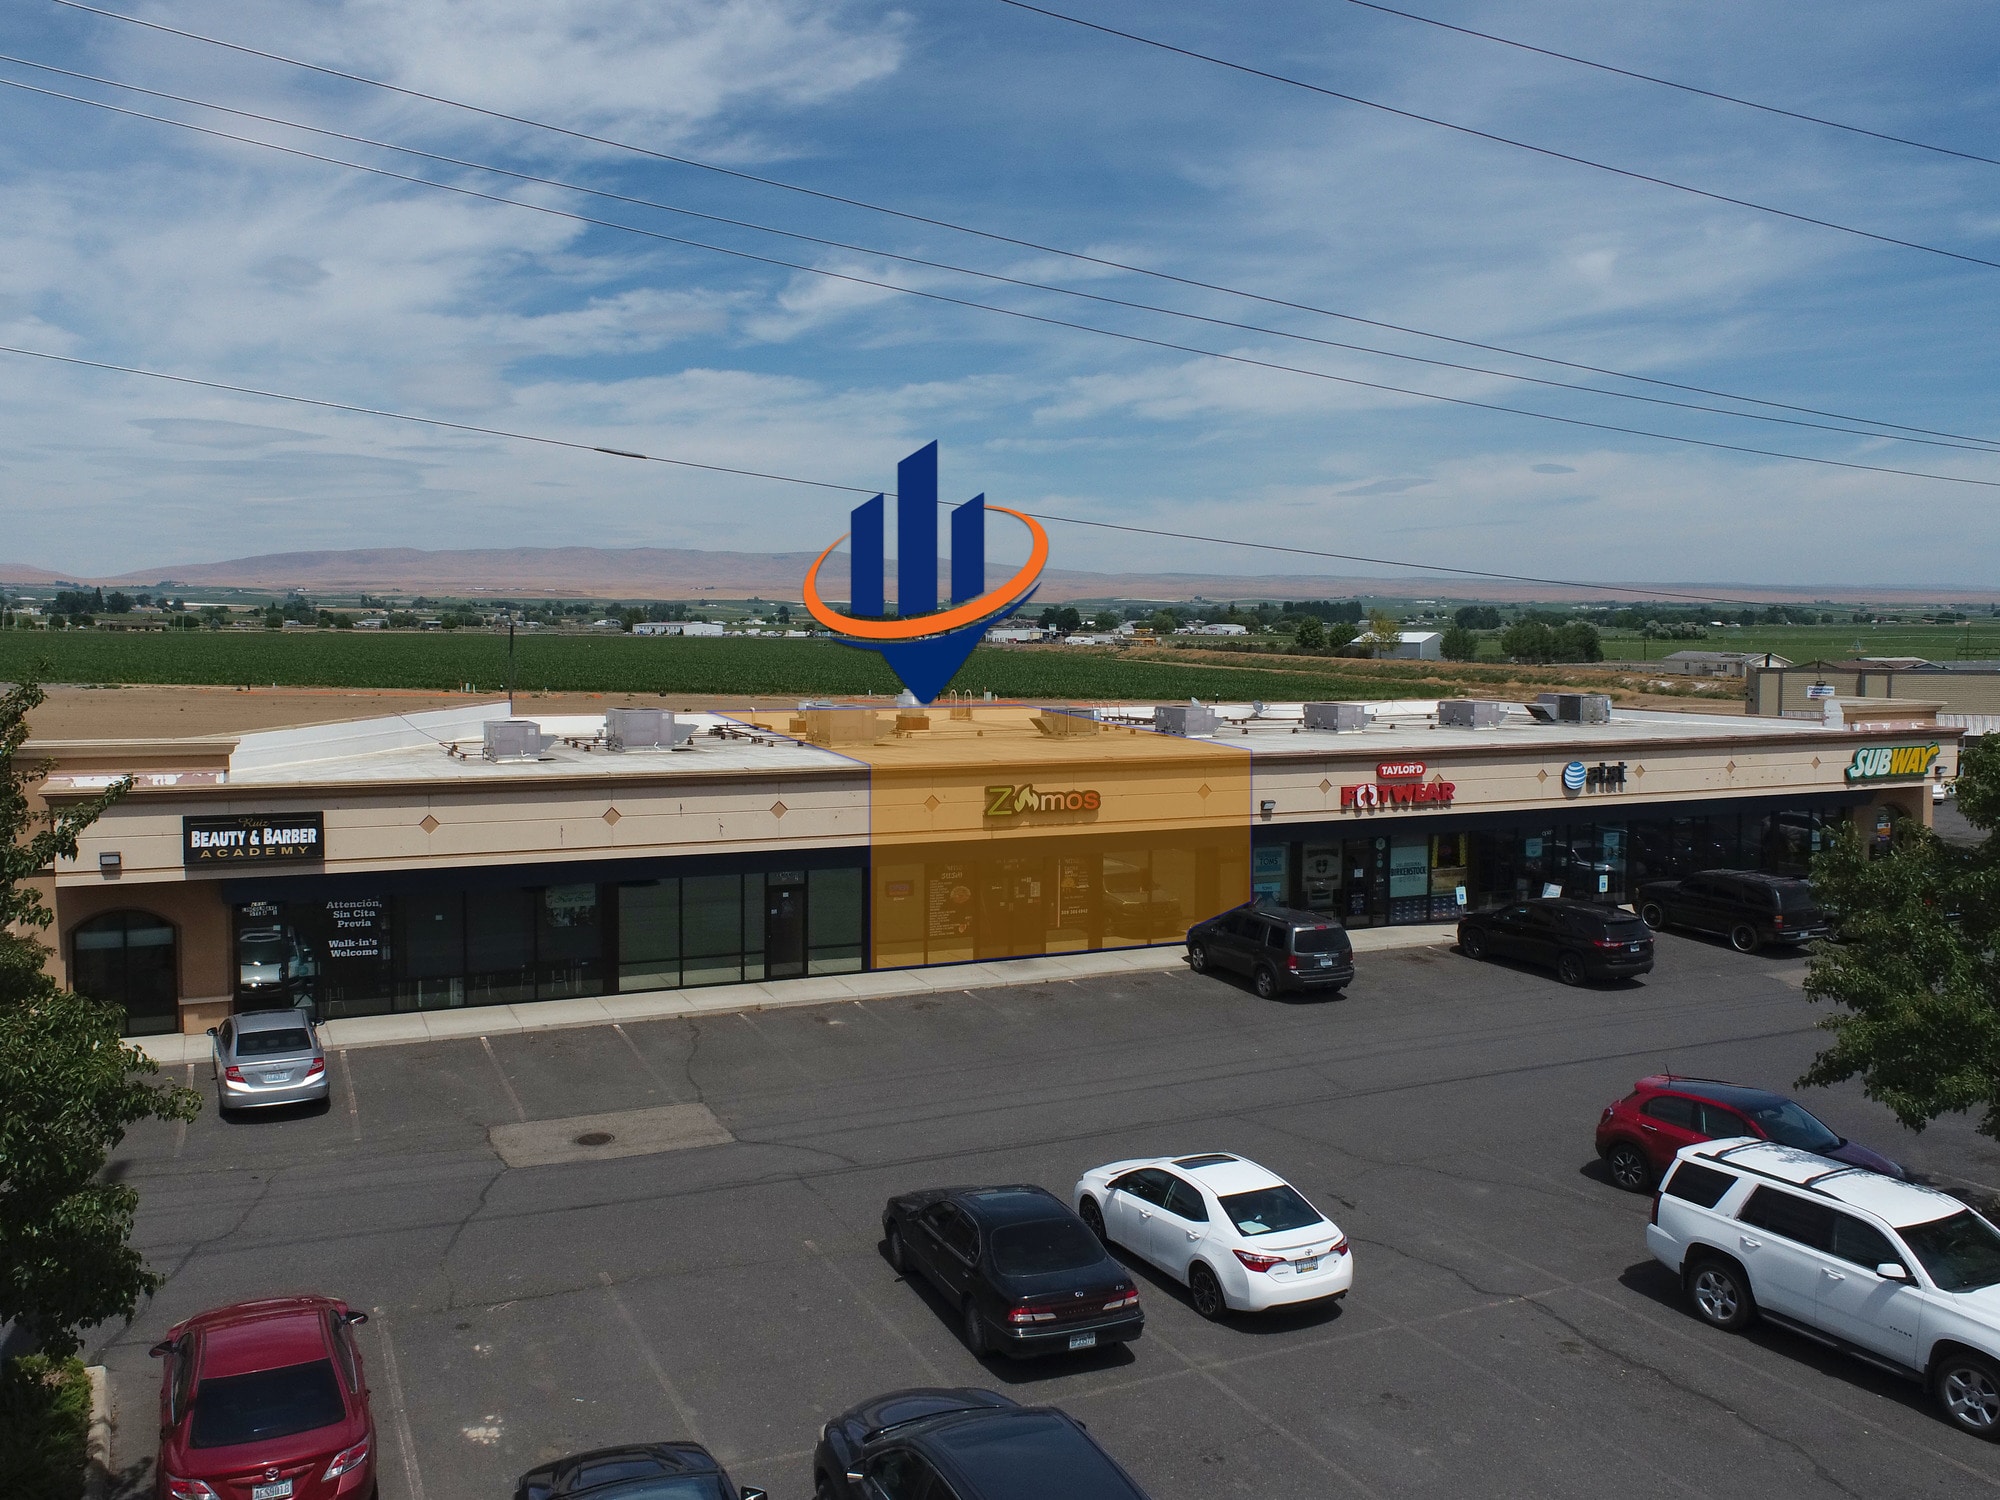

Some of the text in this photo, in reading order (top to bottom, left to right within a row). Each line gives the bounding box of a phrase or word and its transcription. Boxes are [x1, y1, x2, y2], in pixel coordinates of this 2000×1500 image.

[1849, 745, 1939, 778] SUBWAY
[1381, 765, 1423, 776] TAYLOR'D
[1341, 783, 1456, 807] FOOTWEAR
[191, 827, 317, 848] BEAUTY & BARBER
[200, 846, 308, 859] ACADEMY
[353, 910, 376, 918] Cita
[337, 919, 371, 928] Previa
[328, 938, 378, 948] Walk-in's
[330, 949, 379, 957] Welcome
